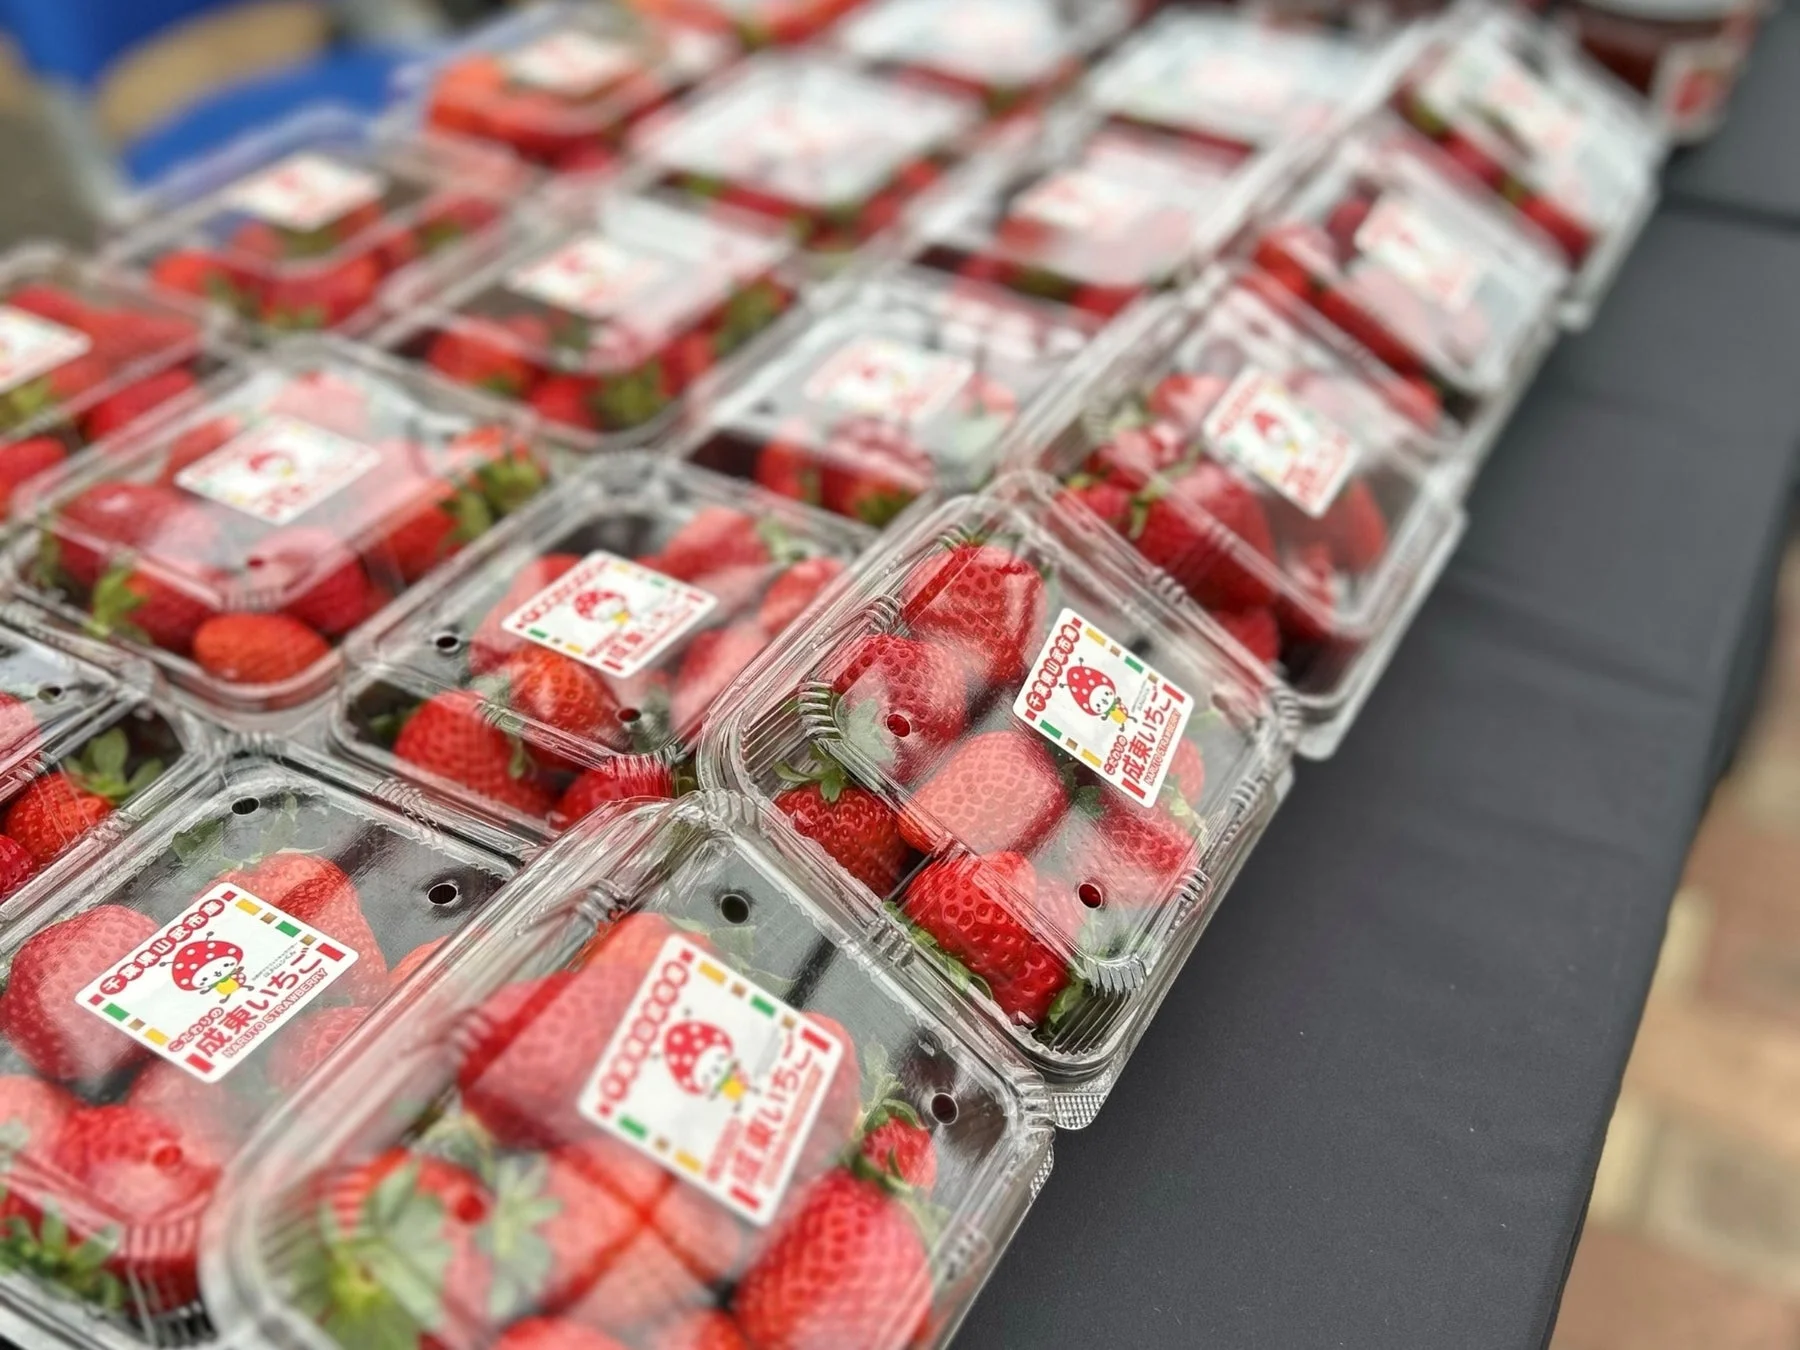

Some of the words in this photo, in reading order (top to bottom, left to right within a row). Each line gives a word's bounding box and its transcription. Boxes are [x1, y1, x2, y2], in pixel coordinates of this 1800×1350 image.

[1122, 685, 1171, 784] 成東いちご
[101, 899, 224, 995] 千葉県山武市産
[168, 1007, 224, 1053] こだわりの
[195, 947, 322, 1058] 成東いちご
[222, 1020, 266, 1059] NARUTO
[265, 967, 329, 1024] STRAWBERRY
